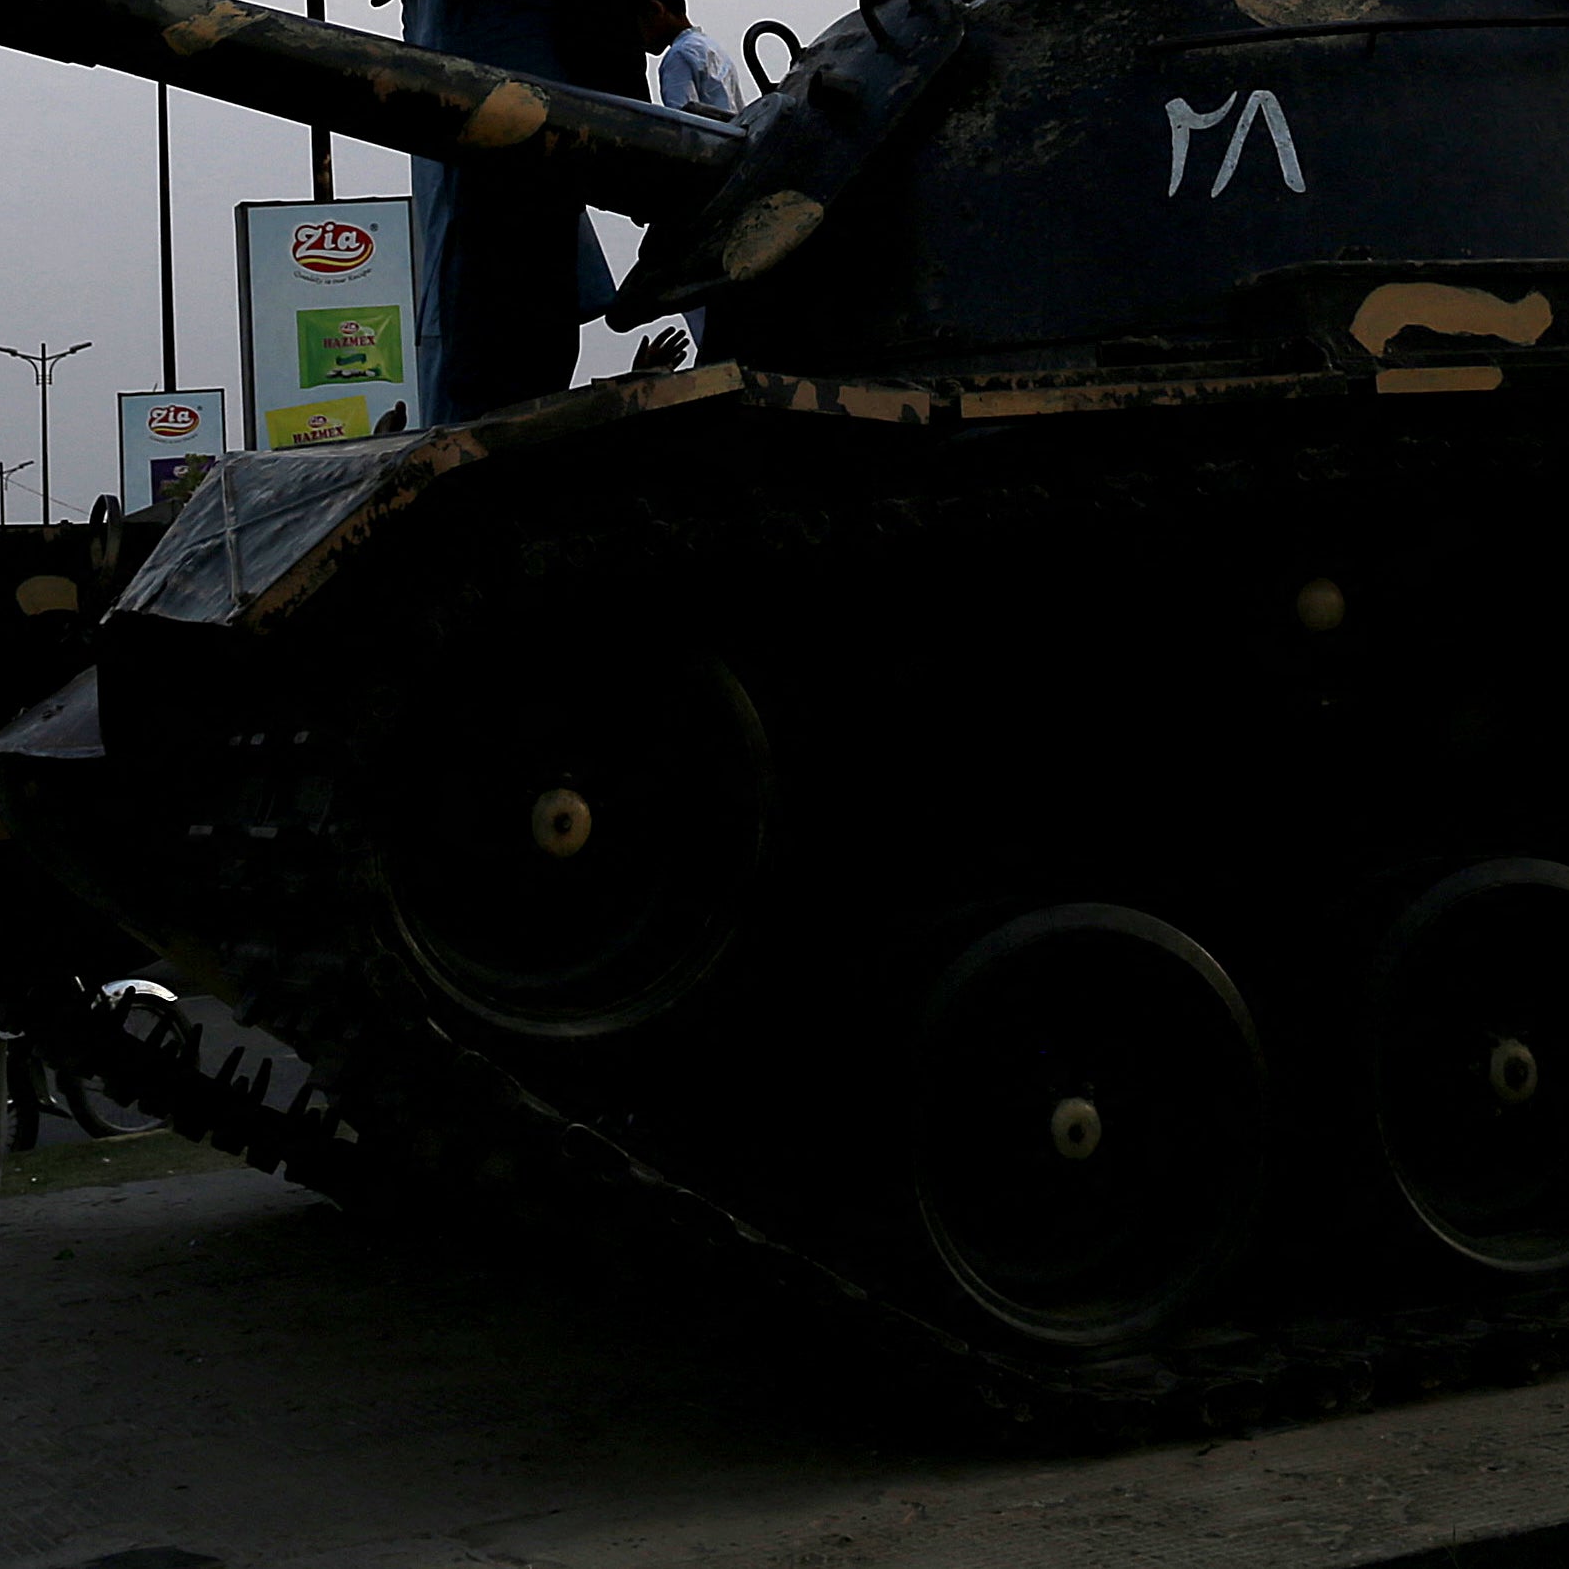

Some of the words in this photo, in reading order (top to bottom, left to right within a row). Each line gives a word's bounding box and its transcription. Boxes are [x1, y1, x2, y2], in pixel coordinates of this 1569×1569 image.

[295, 224, 366, 259] Zia
[323, 335, 375, 349] HAZMEX
[151, 405, 195, 428] Zia
[293, 426, 344, 444] HAZMEX
